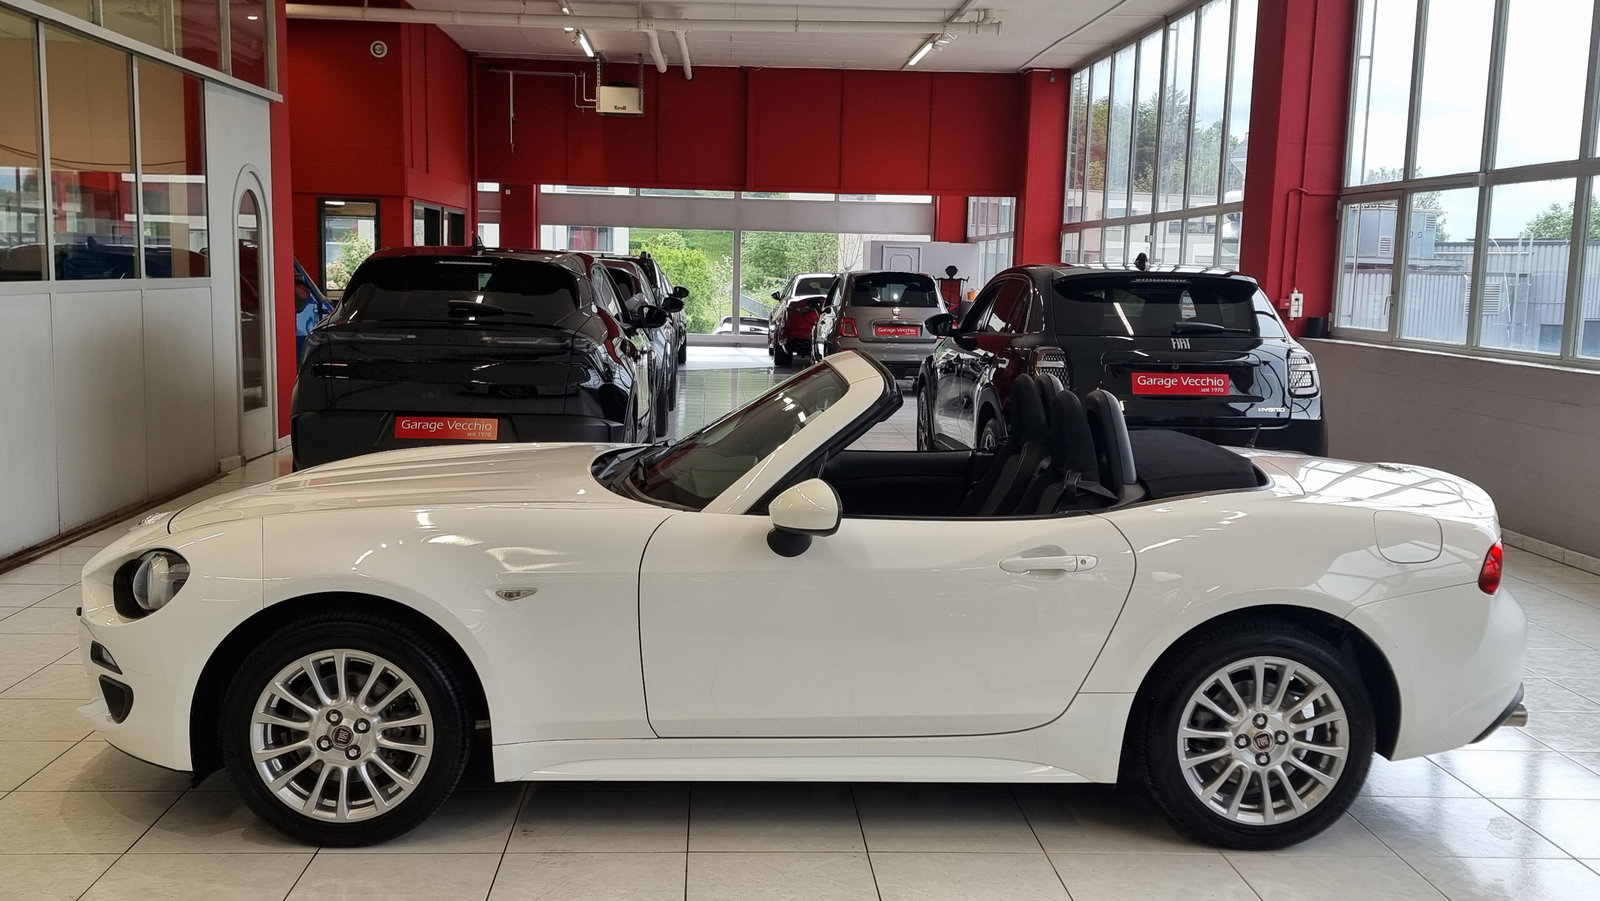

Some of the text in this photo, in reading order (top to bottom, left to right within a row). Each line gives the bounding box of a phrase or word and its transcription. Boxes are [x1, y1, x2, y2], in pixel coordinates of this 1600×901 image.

[1170, 338, 1191, 350] FIAT
[1137, 375, 1224, 388] Garage Vecchio
[401, 419, 493, 432] Garage Vecchio
